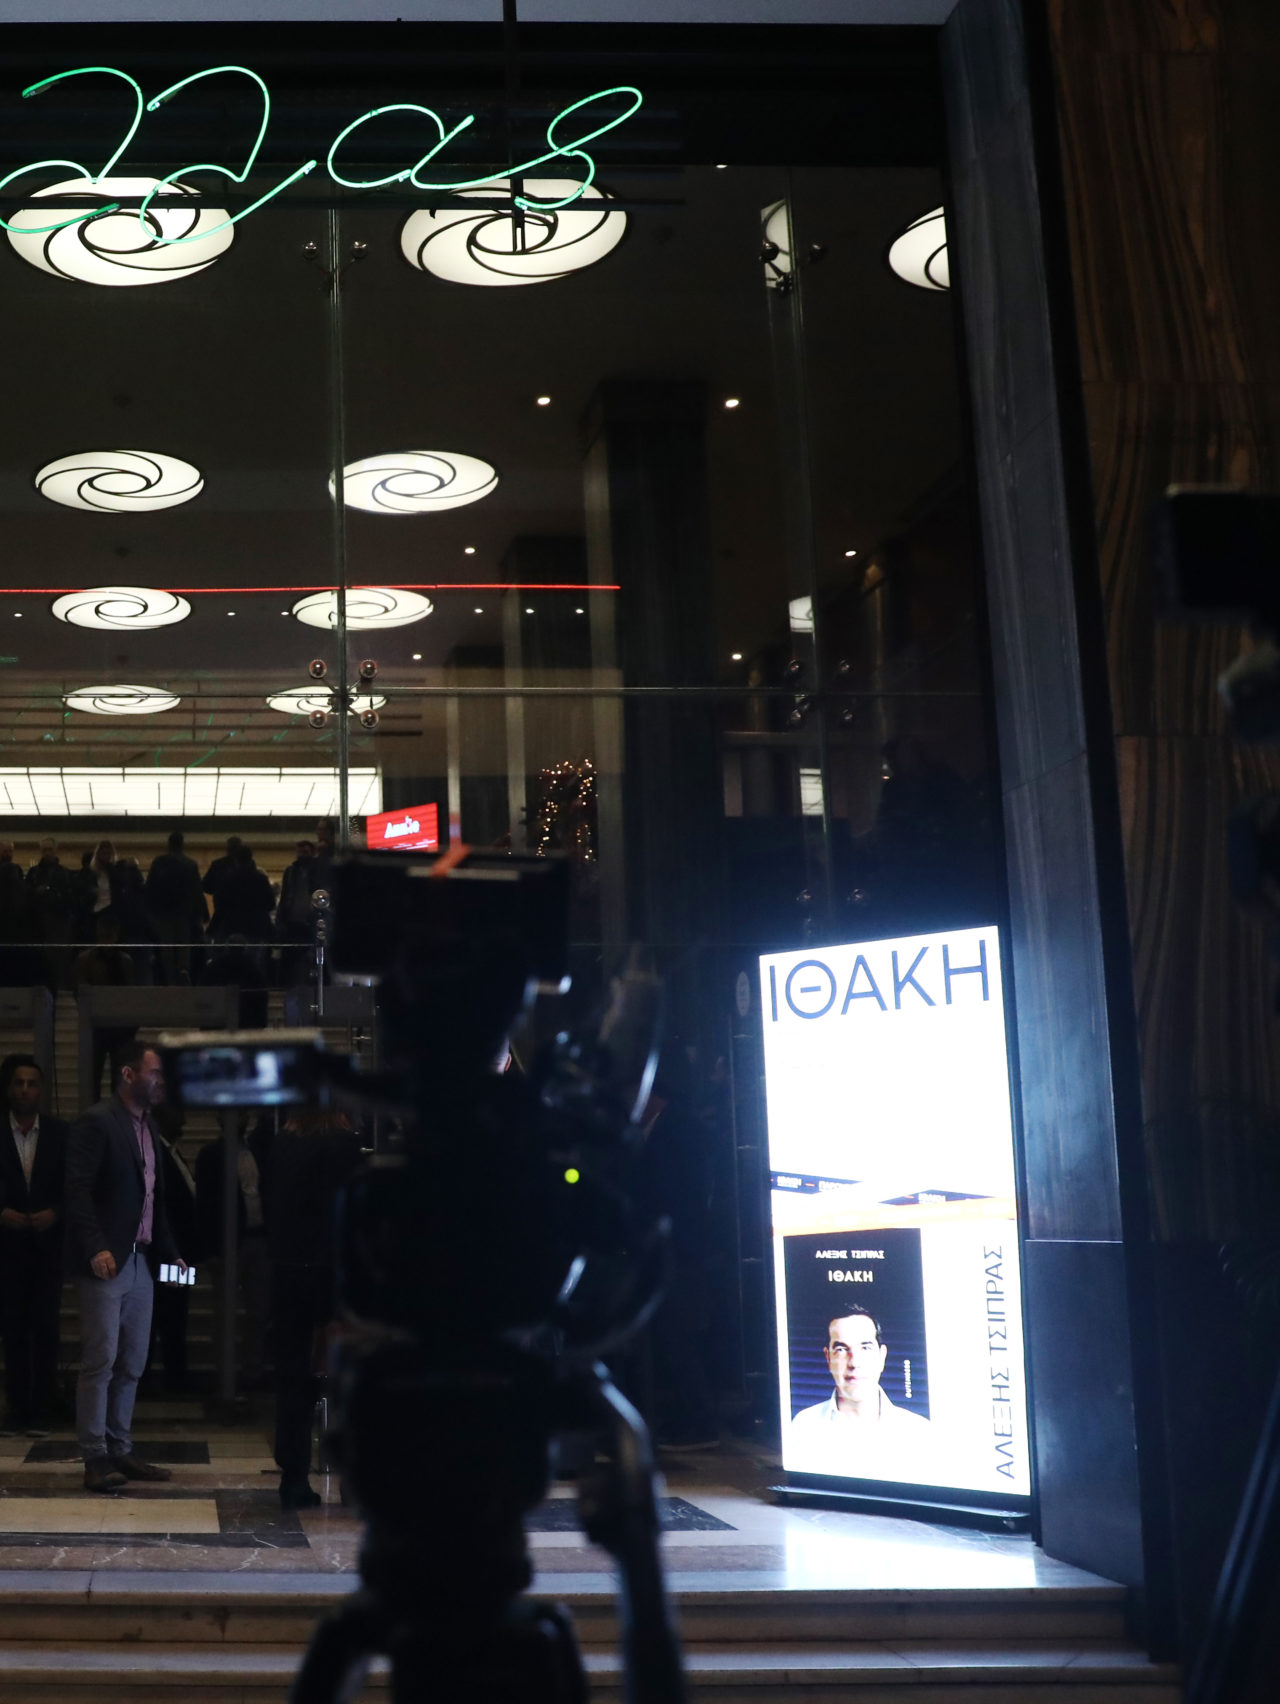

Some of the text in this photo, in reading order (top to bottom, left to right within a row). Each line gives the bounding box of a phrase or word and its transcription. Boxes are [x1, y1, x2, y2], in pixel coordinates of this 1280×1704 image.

[769, 939, 990, 1022] ΙΘΑΚΗ
[828, 1269, 873, 1282] ΙΘΑΚΗ
[983, 1245, 1015, 1480] ΑΛΕΞΗΣ ΤΣΙΠΡΑΣ
